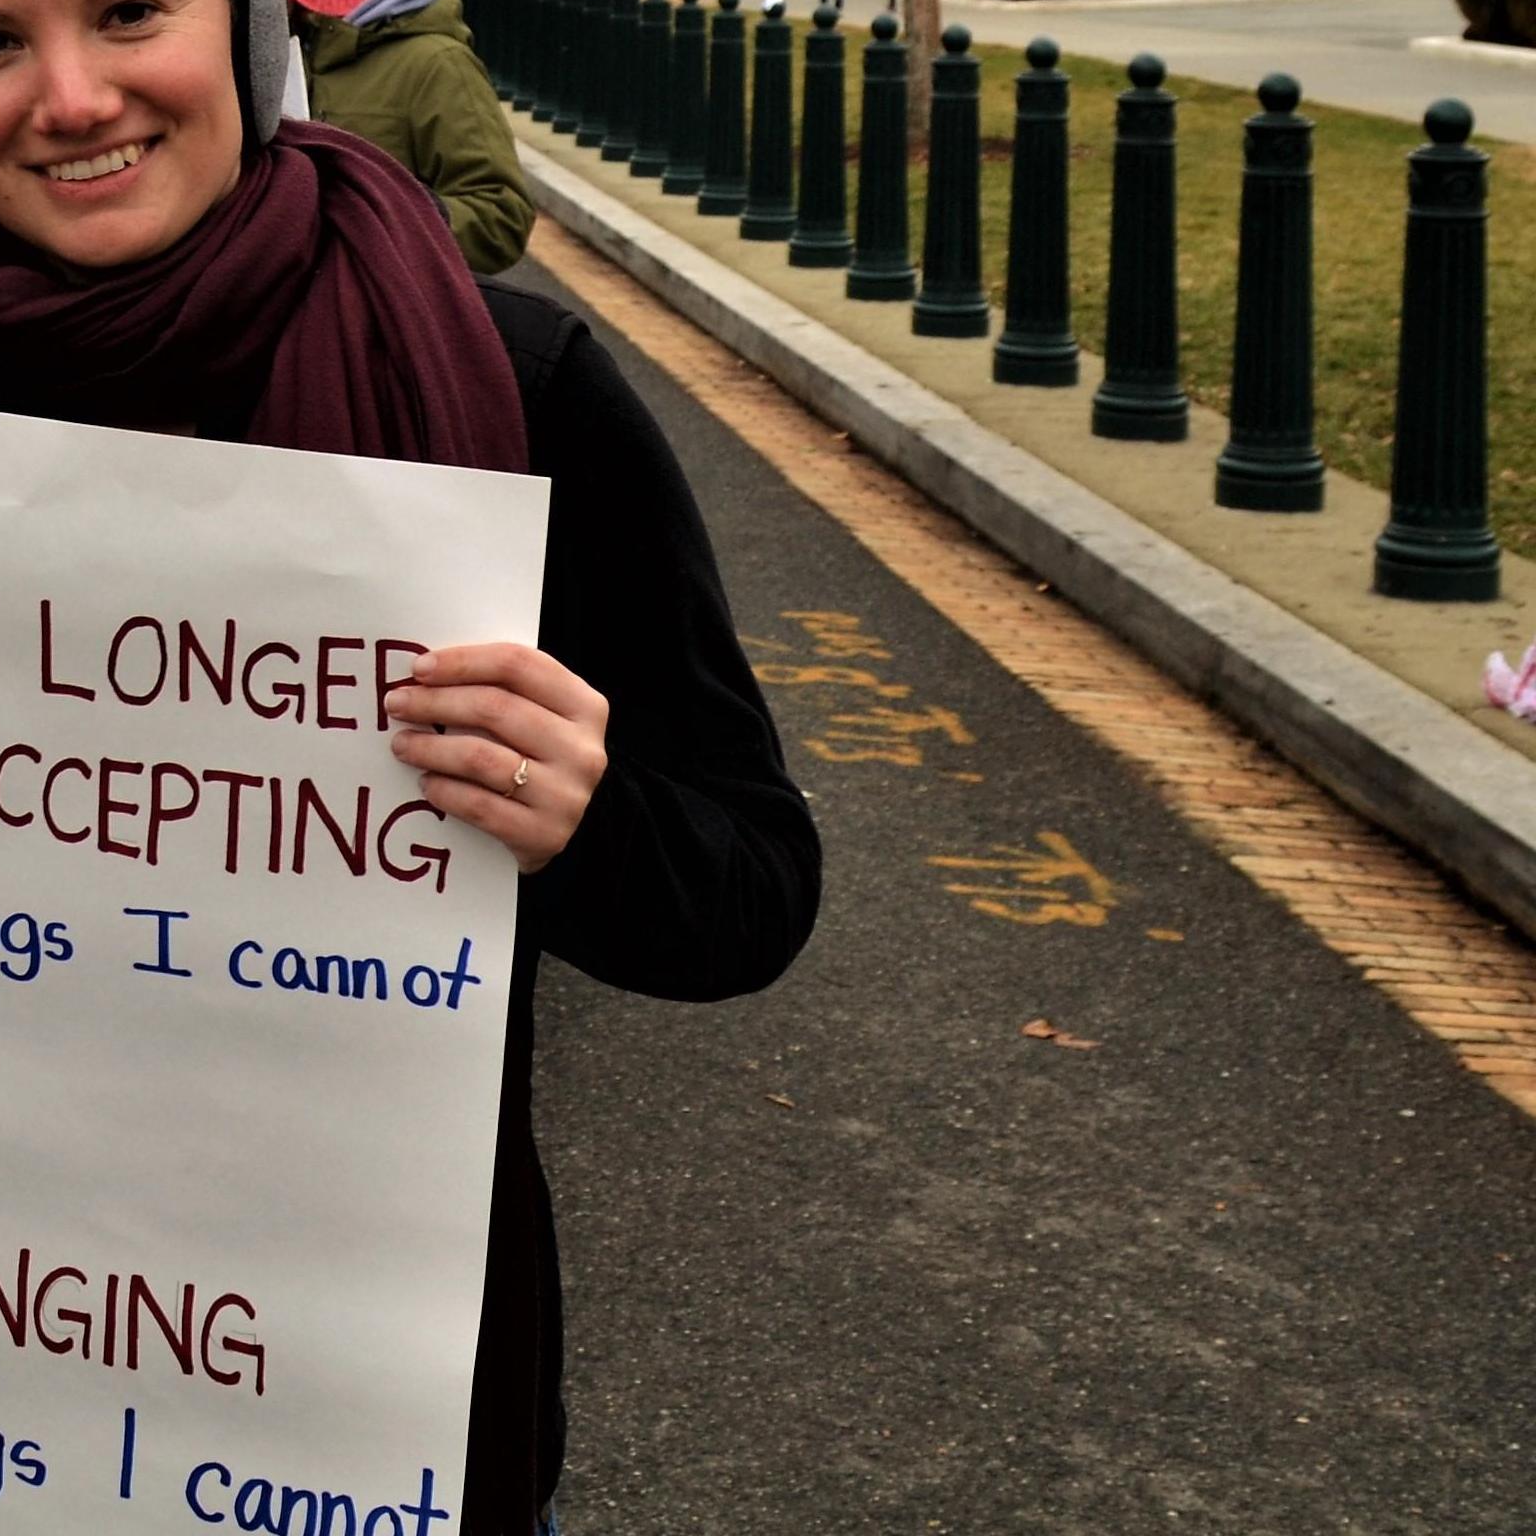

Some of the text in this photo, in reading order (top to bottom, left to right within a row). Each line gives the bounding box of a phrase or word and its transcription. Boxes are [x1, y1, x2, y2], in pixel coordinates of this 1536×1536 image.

[123, 908, 192, 978] I
[229, 938, 481, 1010] cannot
[120, 1408, 136, 1499] I
[185, 1461, 450, 1536] cannot
